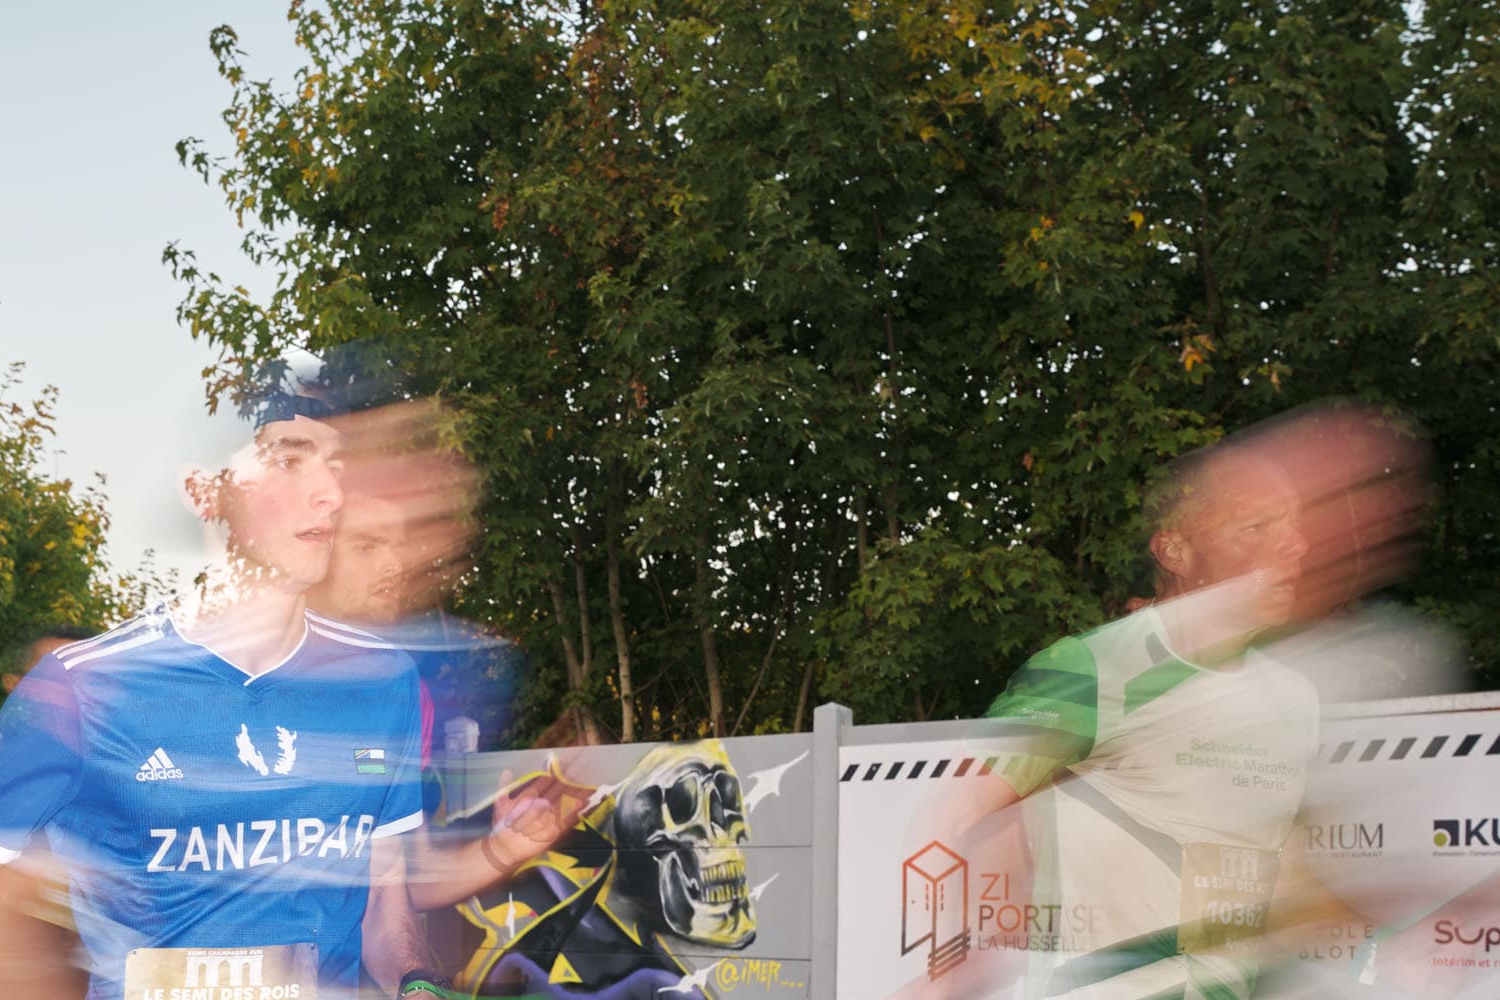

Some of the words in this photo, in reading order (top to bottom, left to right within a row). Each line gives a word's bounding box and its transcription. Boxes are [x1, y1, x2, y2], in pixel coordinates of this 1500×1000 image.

[1190, 738, 1269, 758] Schneider
[1175, 752, 1241, 771] Electric
[135, 767, 184, 782] adidas
[1232, 775, 1249, 788] de
[1253, 776, 1287, 792] Paris
[147, 814, 375, 873] ZANZIBAR
[1307, 822, 1385, 851] RIUM
[980, 872, 1010, 901] ZI
[1194, 876, 1209, 888] LE
[1236, 880, 1255, 892] DES
[978, 904, 1061, 932] PORT
[1072, 904, 1102, 933] SE
[1329, 921, 1374, 939] OLE
[978, 936, 997, 951] LA
[1478, 959, 1490, 968] et
[260, 983, 300, 1000] ROIS
